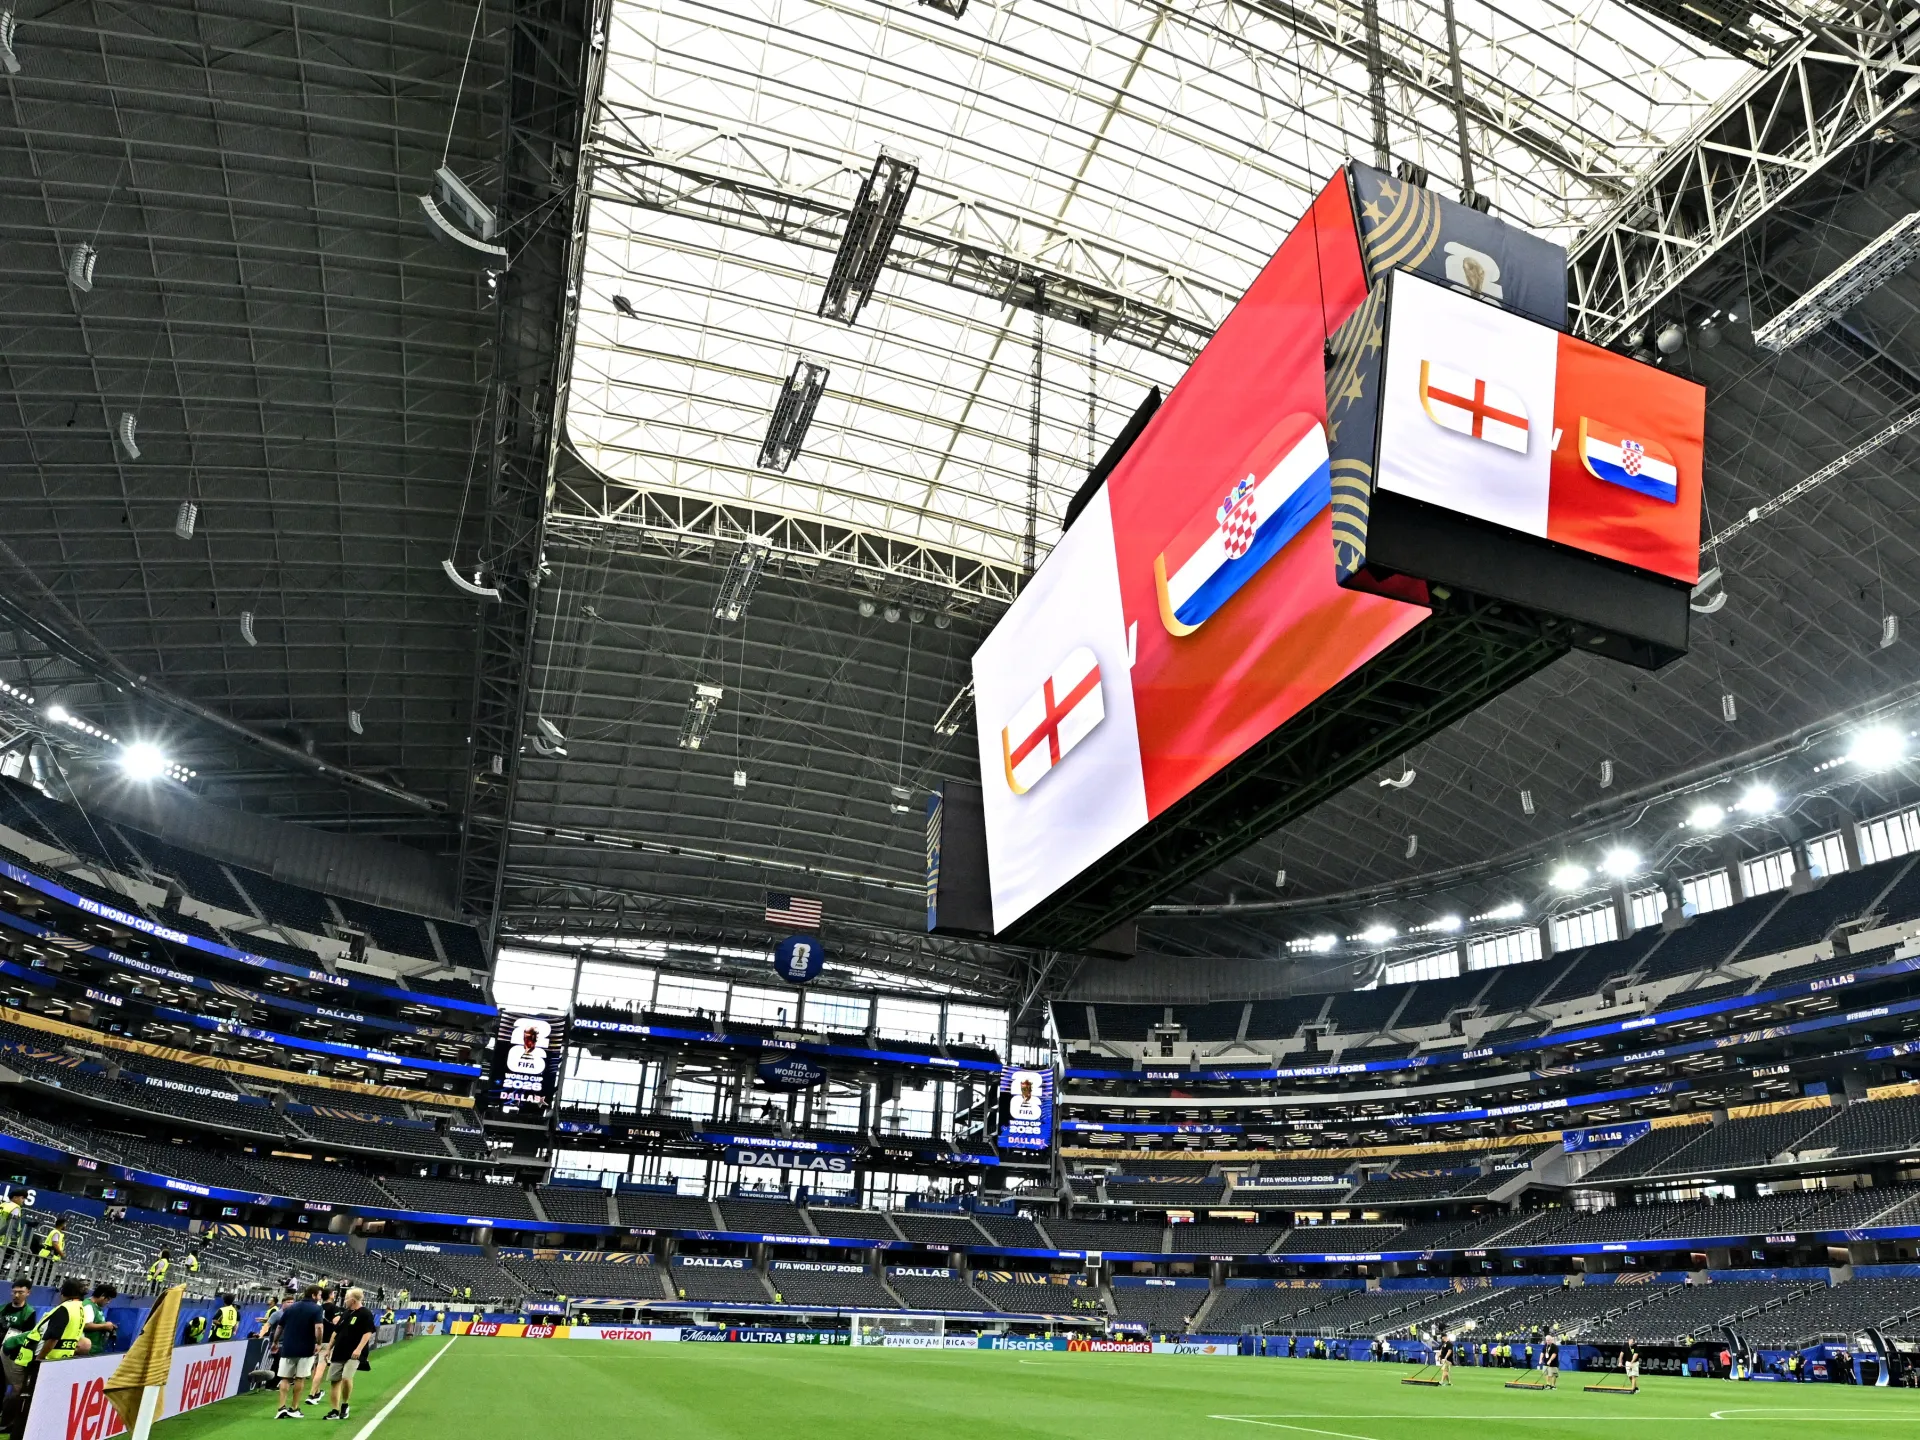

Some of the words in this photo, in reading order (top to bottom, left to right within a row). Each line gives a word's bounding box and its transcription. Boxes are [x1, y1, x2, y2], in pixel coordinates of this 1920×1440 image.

[78, 898, 98, 912] FIFA
[100, 904, 135, 926] WORLD
[135, 920, 154, 932] CUP
[154, 926, 189, 944] 2026
[108, 952, 124, 963] FIFA
[125, 957, 150, 971] WORLD
[151, 966, 167, 975] CUP
[167, 970, 194, 983] 2026
[309, 970, 349, 987] DALLAS
[1810, 974, 1855, 991] DALLAS
[86, 989, 123, 1006] DALLAS
[317, 1007, 364, 1022] DALLAS
[574, 1019, 598, 1029] ORLD
[600, 1022, 618, 1031] CUP
[619, 1024, 650, 1034] 2026
[762, 1039, 797, 1050] DALLAS
[1463, 1047, 1493, 1059] DALLAS
[1624, 1049, 1665, 1062] DALLAS
[518, 1061, 535, 1070] FIFA
[790, 1062, 808, 1071] FIFA
[1277, 1069, 1293, 1077] FIFA
[1294, 1068, 1322, 1076] WORLD
[1323, 1066, 1338, 1074] CUP
[1339, 1064, 1366, 1073] 2026
[1753, 1065, 1790, 1078] DALLAS
[505, 1073, 529, 1081] WORLD
[530, 1075, 544, 1083] CUP
[774, 1068, 804, 1078] WORLD
[805, 1071, 820, 1079] CUP
[503, 1079, 542, 1091] 2026
[781, 1076, 809, 1085] 2026
[145, 1077, 163, 1087] FIFA
[165, 1081, 193, 1093] WORLD
[194, 1087, 211, 1096] CUP
[211, 1090, 239, 1101] 2026
[500, 1091, 541, 1104] DALLAS
[1487, 1107, 1503, 1117] FIFA
[1503, 1104, 1527, 1115] WORLD
[1528, 1103, 1542, 1111] CUP
[1542, 1099, 1567, 1110] 2026
[449, 1126, 481, 1134] DALLAS
[628, 1128, 660, 1138] DALLAS
[1009, 1126, 1041, 1134] 2026
[1294, 1123, 1323, 1131] DALLAS
[733, 1136, 750, 1145] FIFA
[750, 1138, 776, 1147] WORLD
[777, 1139, 791, 1148] CUP
[792, 1141, 817, 1150] 2026
[1008, 1137, 1041, 1145] DALLAS
[1588, 1131, 1622, 1143] DALLAS
[884, 1149, 913, 1157] DALLAS
[738, 1150, 846, 1172] DALLAS
[1495, 1162, 1529, 1171] DALLAS
[304, 1202, 332, 1211] DALLAS
[1766, 1235, 1796, 1243] DALLAS
[683, 1257, 743, 1268] DALLAS
[775, 1262, 792, 1270] FIFA
[792, 1263, 820, 1271] WORLD
[821, 1264, 836, 1272] CUP
[837, 1265, 863, 1273] 2026
[896, 1267, 950, 1278] DALLAS
[528, 1303, 559, 1312] DALLAS
[470, 1322, 497, 1336] Lay's
[526, 1324, 553, 1338] Lay's
[1115, 1323, 1142, 1331] DALLAS
[601, 1328, 652, 1341] verizon
[682, 1329, 727, 1342] Michelob
[740, 1332, 782, 1343] ULTRA
[887, 1337, 911, 1346] BANK
[926, 1338, 966, 1346] AMRICA
[992, 1338, 1054, 1351] Hisense
[1091, 1341, 1150, 1353] McDonald's
[1174, 1343, 1200, 1355] Dove
[179, 1344, 232, 1412] verizon
